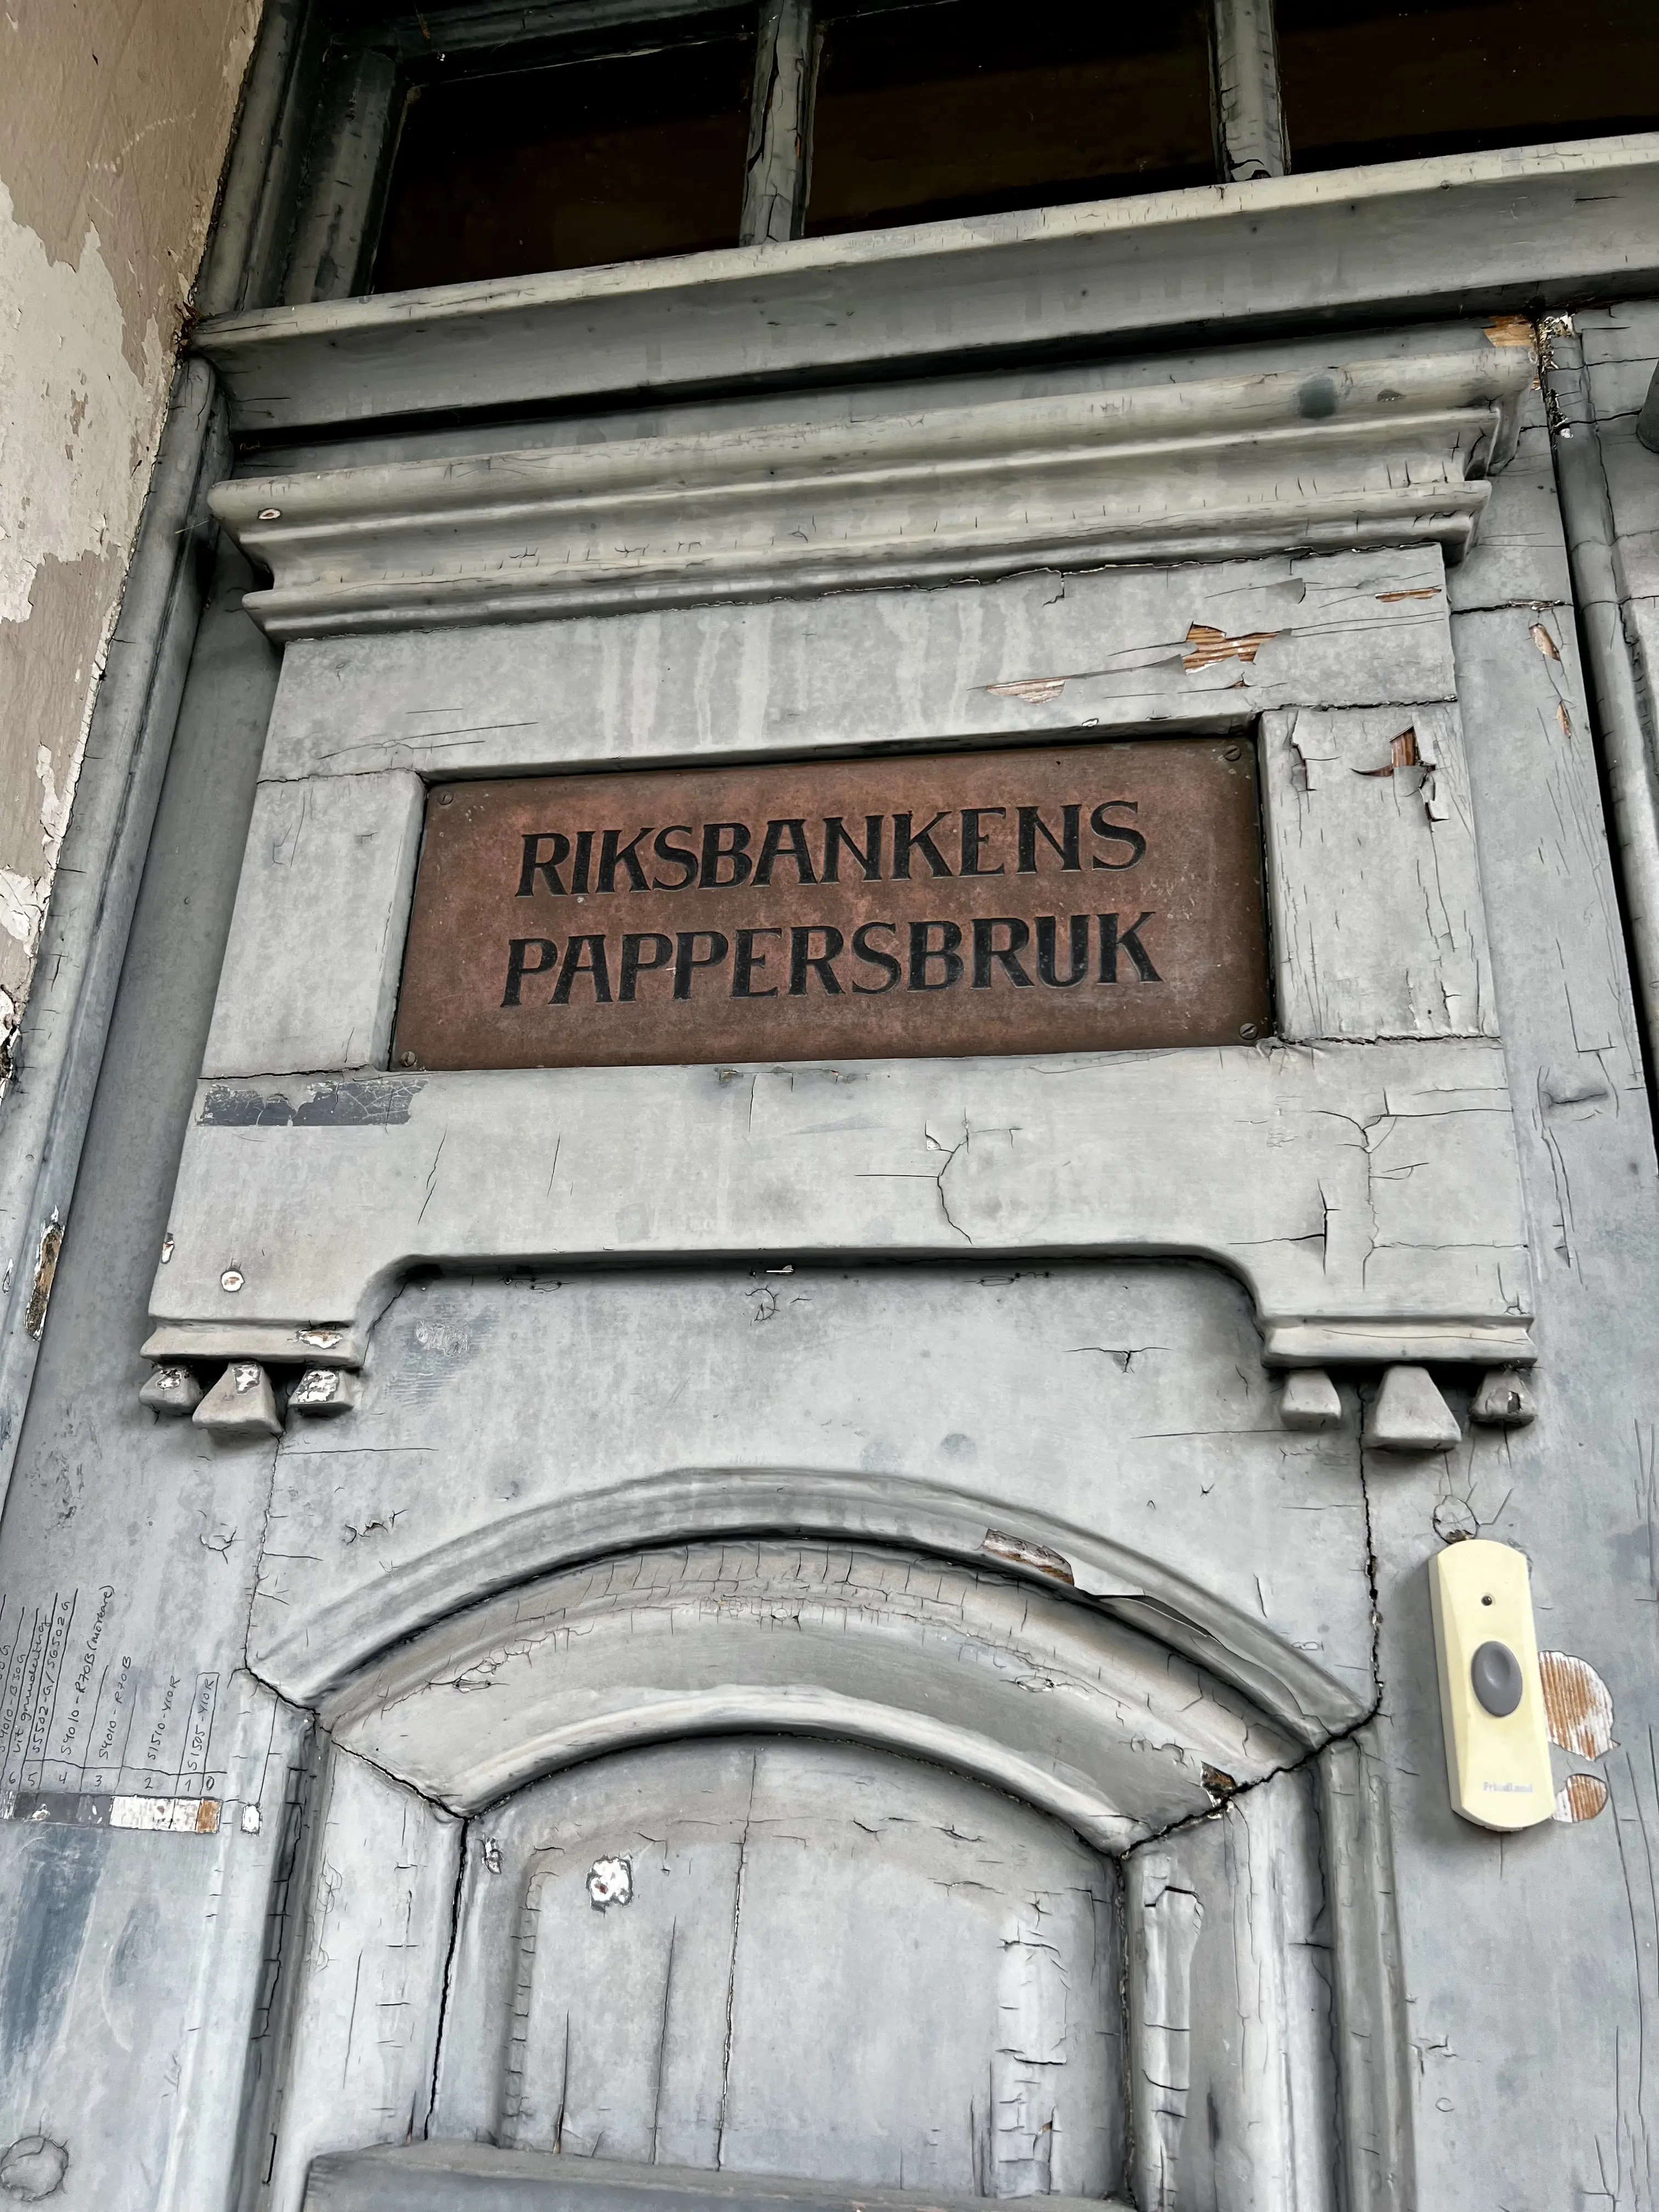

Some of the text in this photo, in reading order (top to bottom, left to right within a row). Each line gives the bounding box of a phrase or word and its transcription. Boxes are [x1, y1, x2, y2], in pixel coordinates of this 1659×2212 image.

[515, 800, 1147, 897] RIKSBANKENS
[500, 911, 1163, 1008] PAPPERSBRUK
[9, 1771, 16, 1784] 6
[28, 1772, 38, 1786] 5
[59, 1771, 67, 1784] 4
[95, 1775, 103, 1788] 3
[144, 1778, 153, 1790] 2
[185, 1779, 191, 1792] 1
